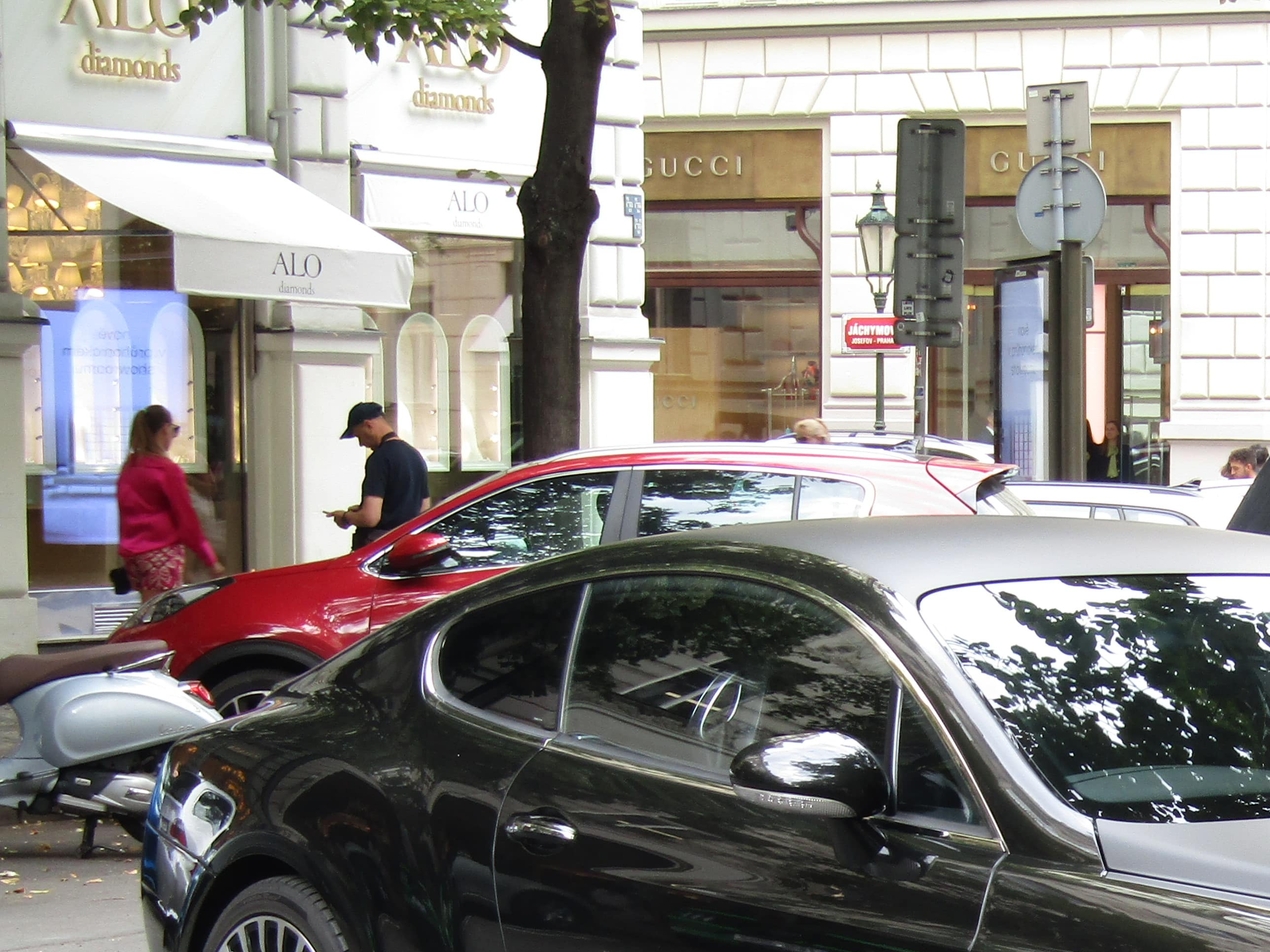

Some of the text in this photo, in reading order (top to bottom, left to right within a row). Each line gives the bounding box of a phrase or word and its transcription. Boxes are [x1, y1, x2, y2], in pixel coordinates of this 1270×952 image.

[81, 41, 181, 82] diamonds
[412, 77, 495, 114] diamonds
[990, 150, 1106, 173] GUI
[447, 190, 489, 213] ALO
[271, 251, 322, 279] ALO
[278, 280, 316, 296] diamonds
[847, 323, 894, 336] JÁCHYMOV
[851, 337, 873, 345] JOSEFOV
